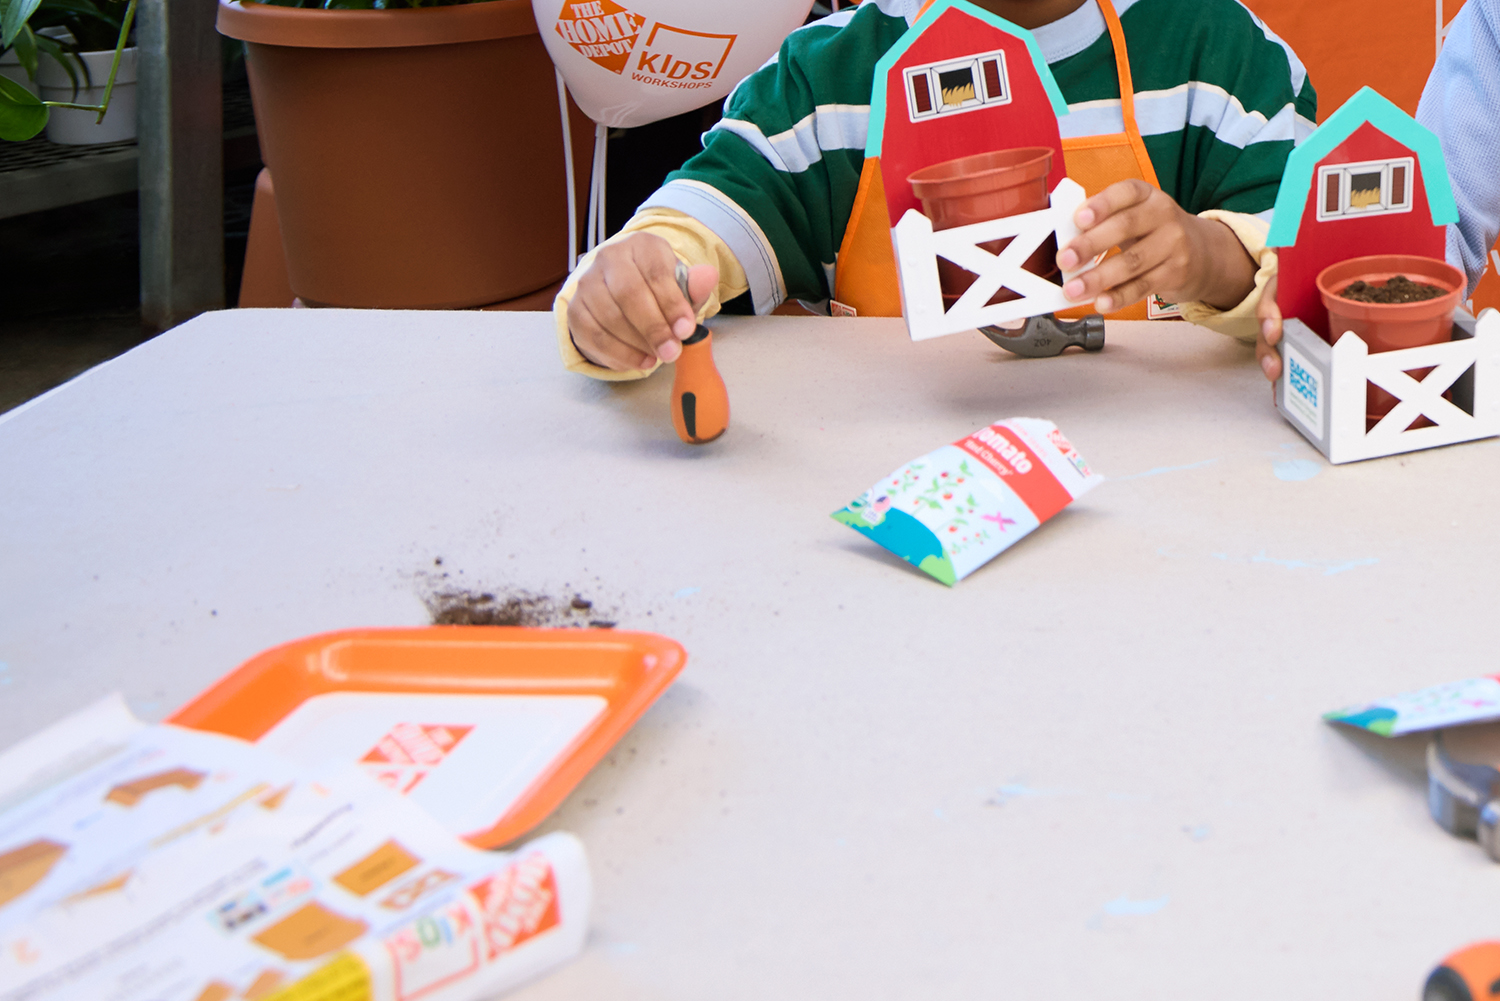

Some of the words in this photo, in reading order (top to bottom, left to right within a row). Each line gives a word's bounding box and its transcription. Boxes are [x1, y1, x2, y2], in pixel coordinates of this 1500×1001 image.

[570, 0, 605, 19] THE
[557, 10, 643, 45] HOME
[578, 38, 634, 58] DEPOT
[637, 51, 713, 80] KIDS
[631, 72, 713, 90] WORKSHOPS
